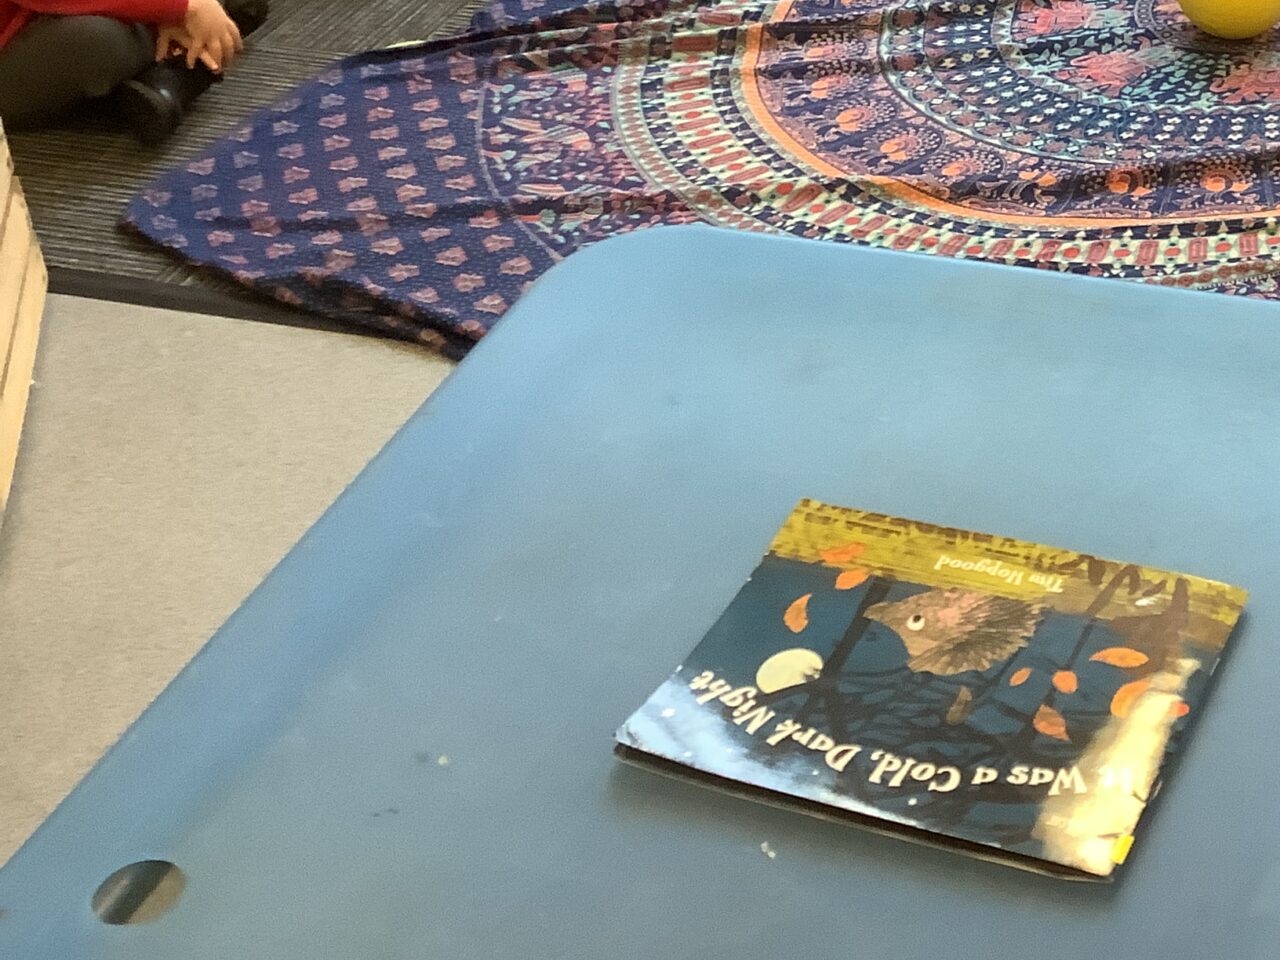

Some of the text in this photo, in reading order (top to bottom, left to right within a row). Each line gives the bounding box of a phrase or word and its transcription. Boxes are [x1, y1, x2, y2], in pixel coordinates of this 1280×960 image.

[933, 555, 1064, 593] Tim Hopgood
[688, 670, 777, 735] Night
[766, 718, 863, 772] Dark
[869, 748, 961, 792] Cold,
[971, 766, 999, 785] a
[1006, 765, 1088, 796] Was
